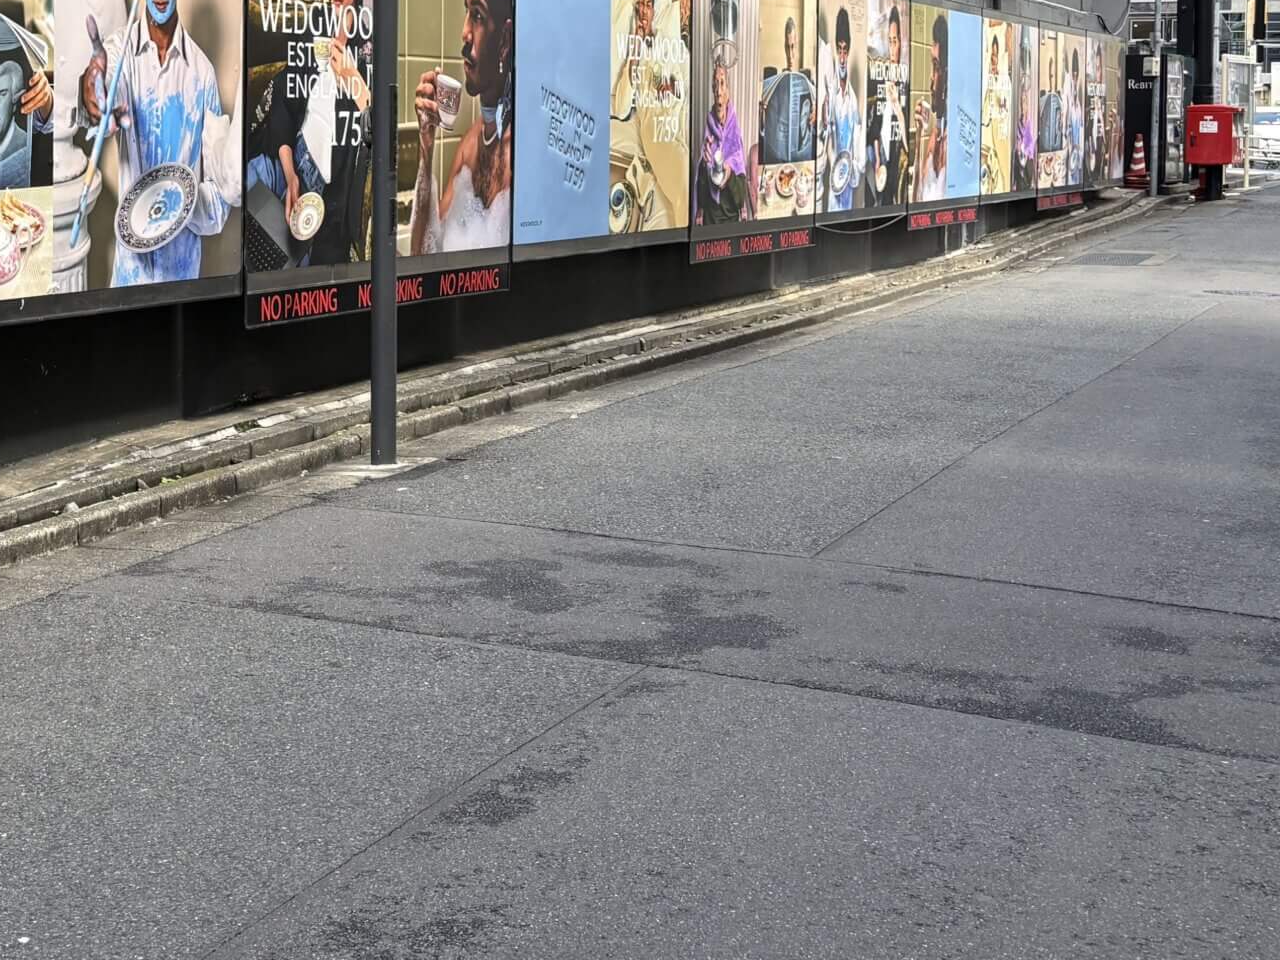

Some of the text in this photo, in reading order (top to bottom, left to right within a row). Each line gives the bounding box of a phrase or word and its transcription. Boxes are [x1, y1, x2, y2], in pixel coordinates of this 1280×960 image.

[616, 32, 685, 63] WEDGWOOD
[541, 85, 596, 137] WEDGWOOD
[653, 116, 680, 143] 1759
[440, 268, 500, 296] NO PARKING
[260, 287, 338, 321] NO PARKING
